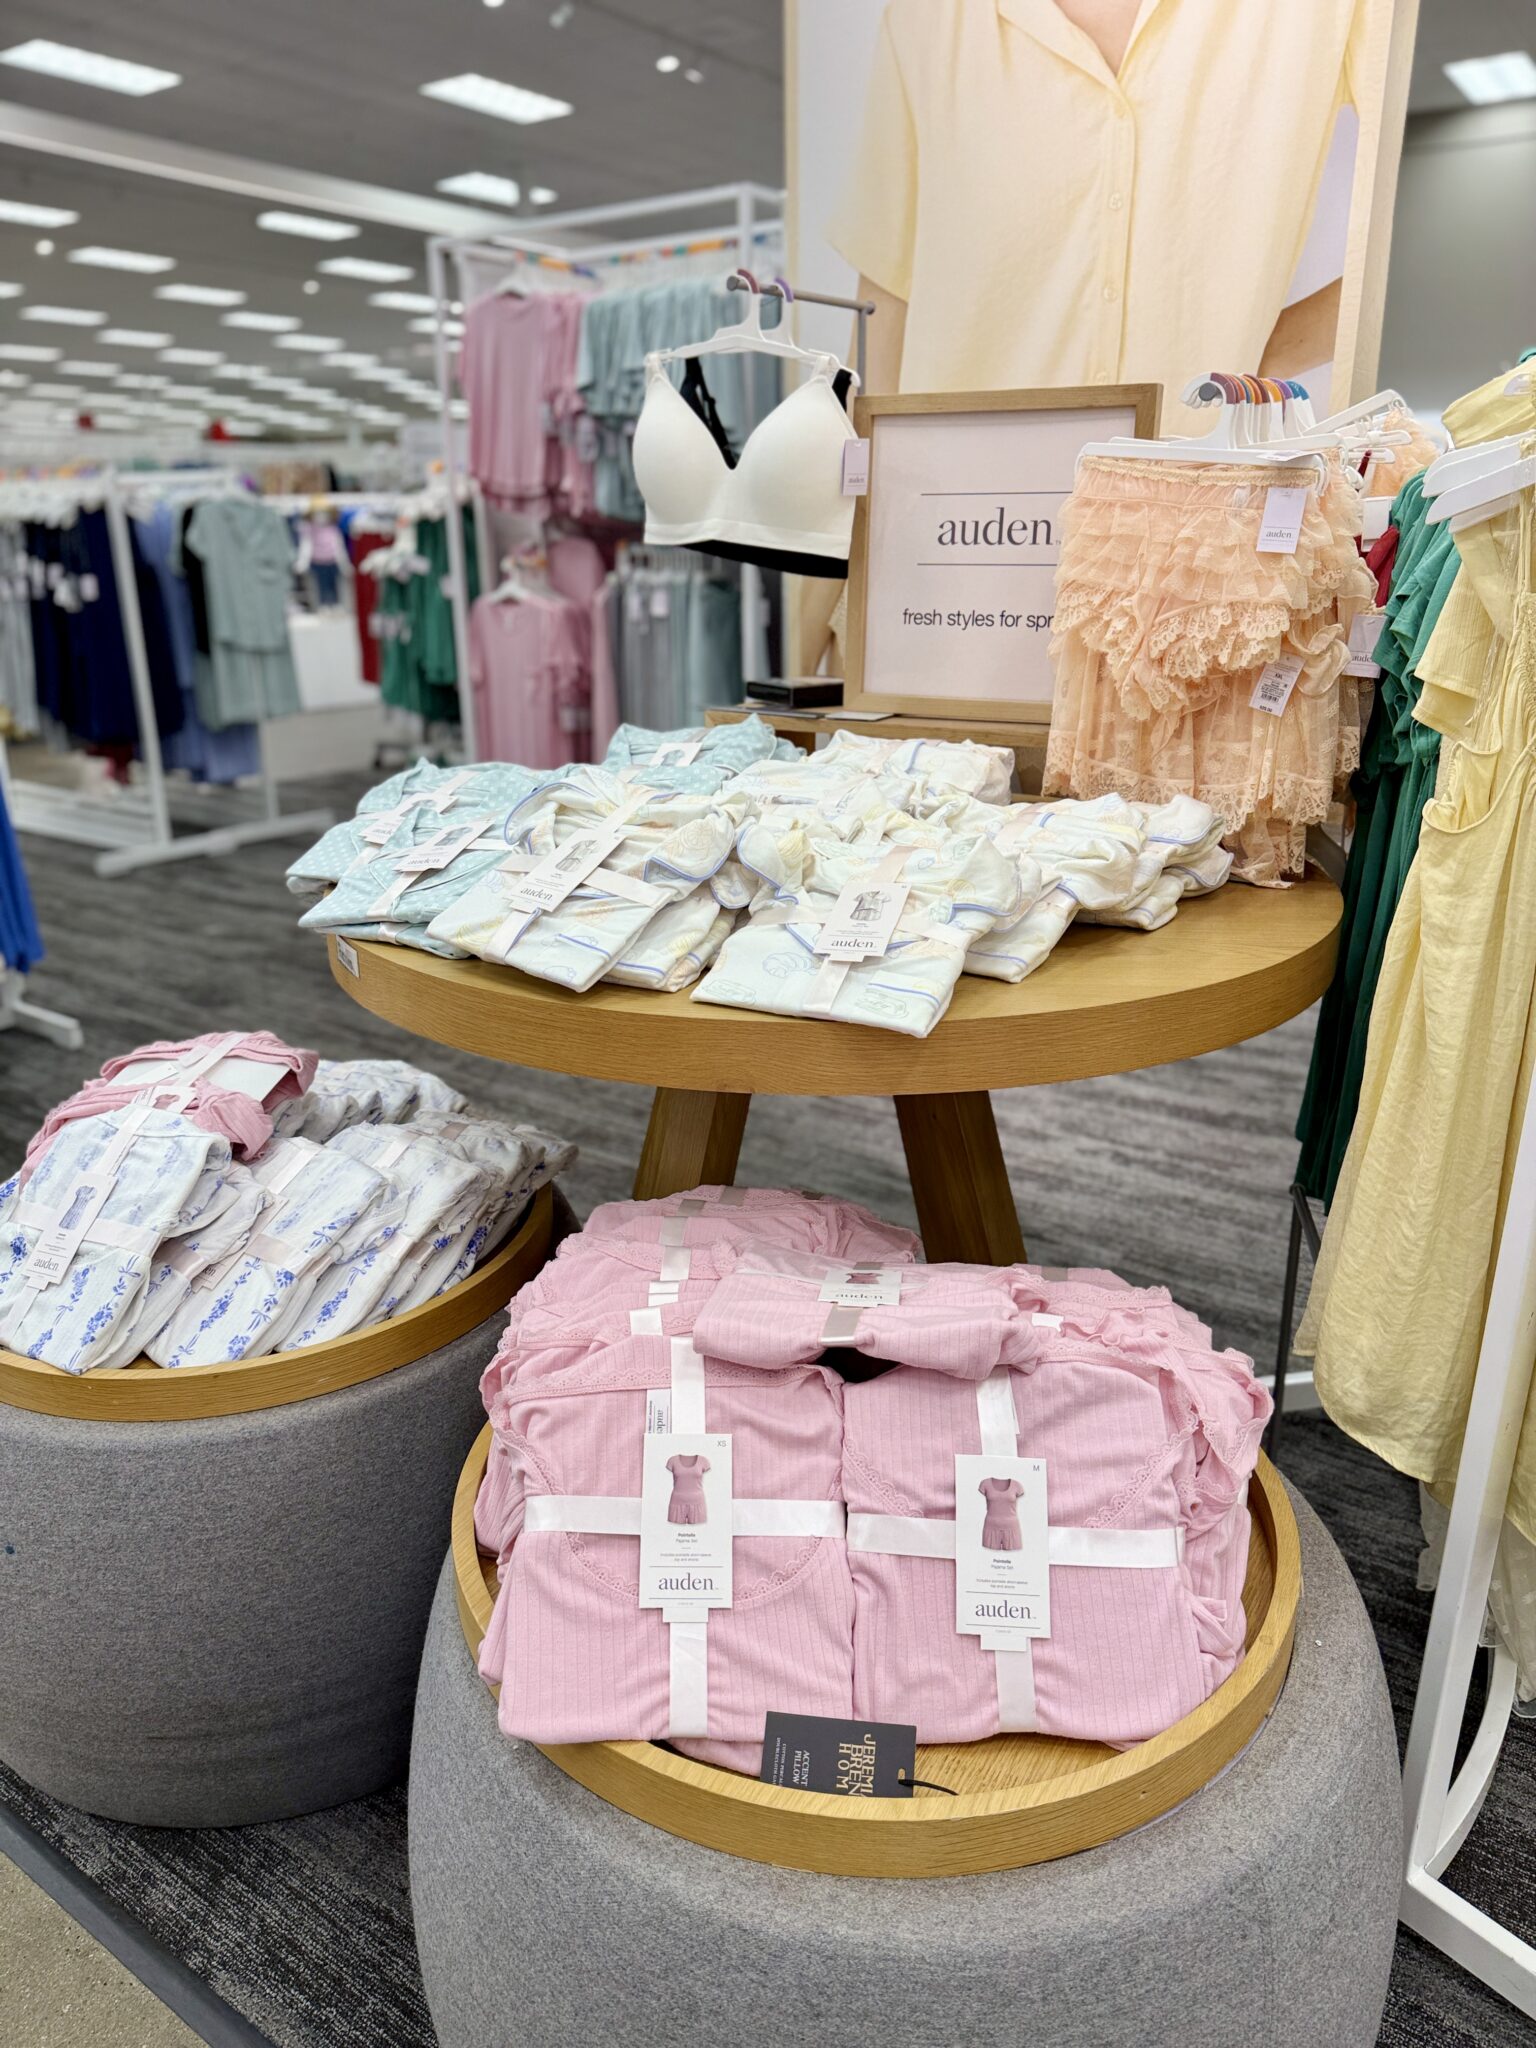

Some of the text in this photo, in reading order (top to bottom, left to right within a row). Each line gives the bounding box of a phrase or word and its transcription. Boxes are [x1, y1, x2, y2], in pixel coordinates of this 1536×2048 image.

[938, 507, 1053, 545] auden
[1266, 530, 1292, 538] auden
[903, 608, 1054, 632] fresh styles for spr
[520, 888, 553, 901] auden
[831, 938, 874, 948] auden
[34, 1257, 60, 1271] auden
[658, 1572, 713, 1591] auden
[975, 1600, 1031, 1619] auden
[792, 1750, 802, 1785] PILLOW
[801, 1750, 810, 1786] ACCENT
[860, 1733, 876, 1797] JEREMI
